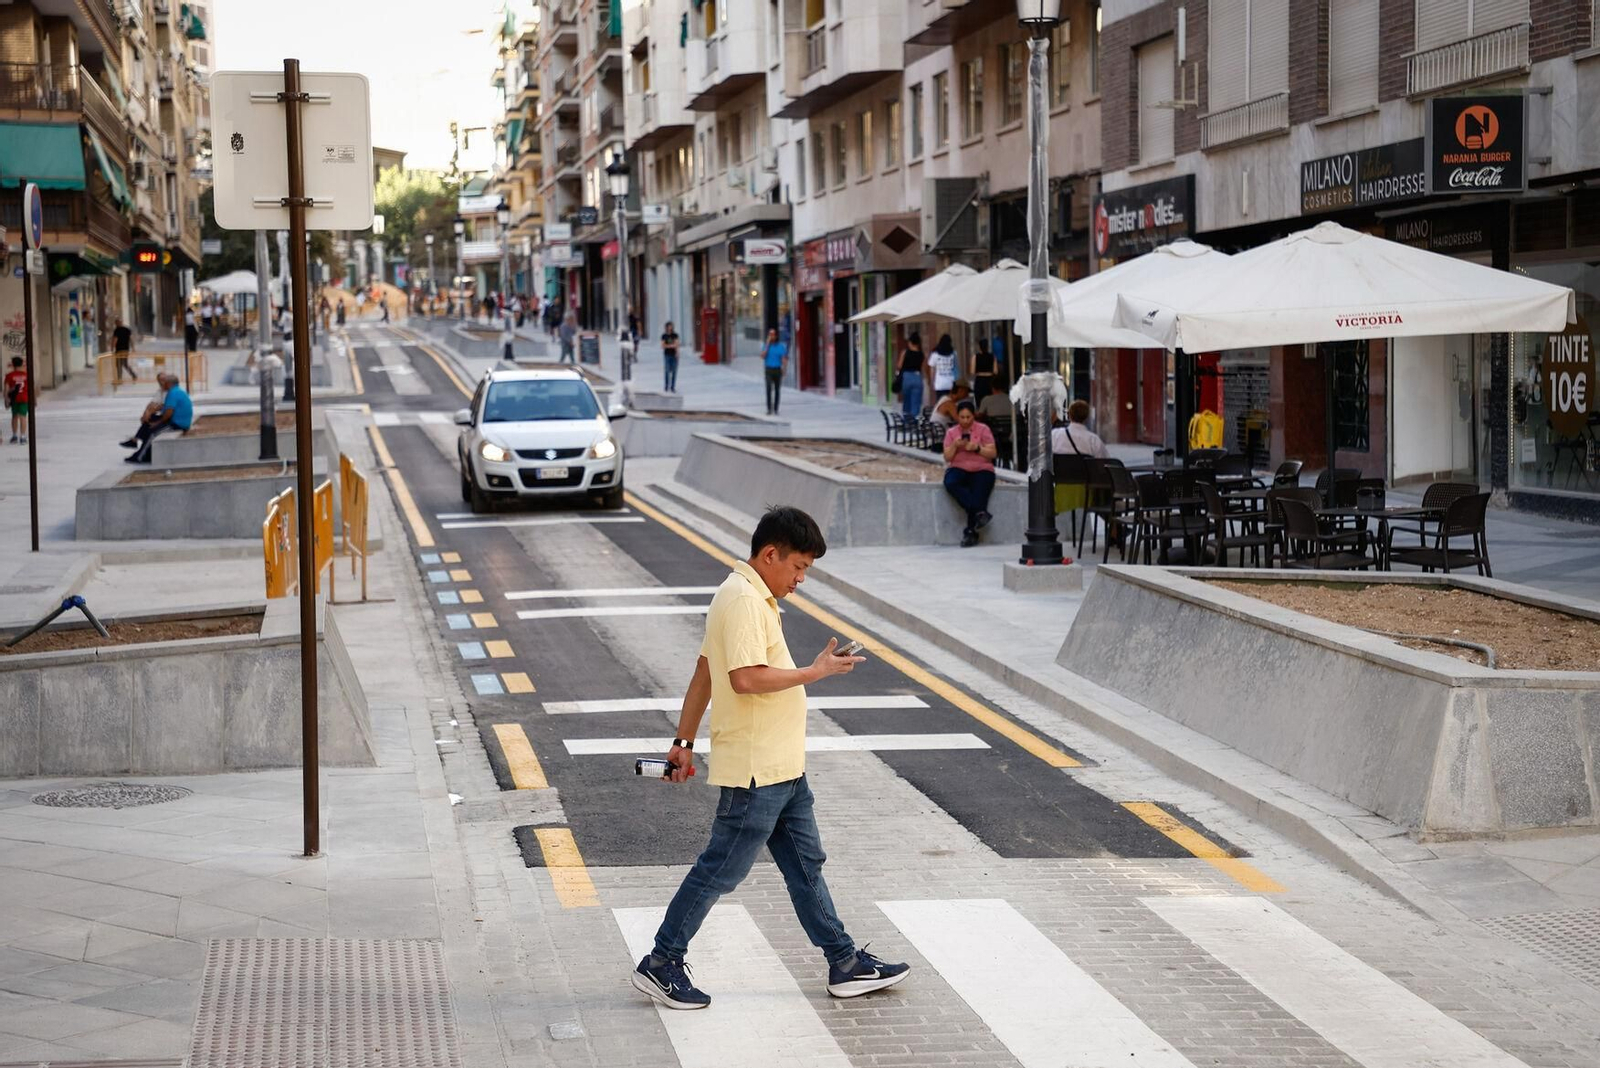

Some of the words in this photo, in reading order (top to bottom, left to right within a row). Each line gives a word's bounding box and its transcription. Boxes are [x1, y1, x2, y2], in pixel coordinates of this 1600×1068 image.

[1443, 153, 1478, 164] NARANJA
[1480, 151, 1511, 163] BURGER
[1303, 154, 1353, 193] MILANO
[1303, 188, 1353, 210] COSMETICS
[1108, 205, 1137, 235] mister
[1395, 219, 1429, 241] MILANO
[1433, 231, 1483, 249] HAIRDRESSERS
[1335, 314, 1403, 327] VICTORIA
[1549, 334, 1589, 363] TINTE
[1549, 371, 1587, 414] 10€
